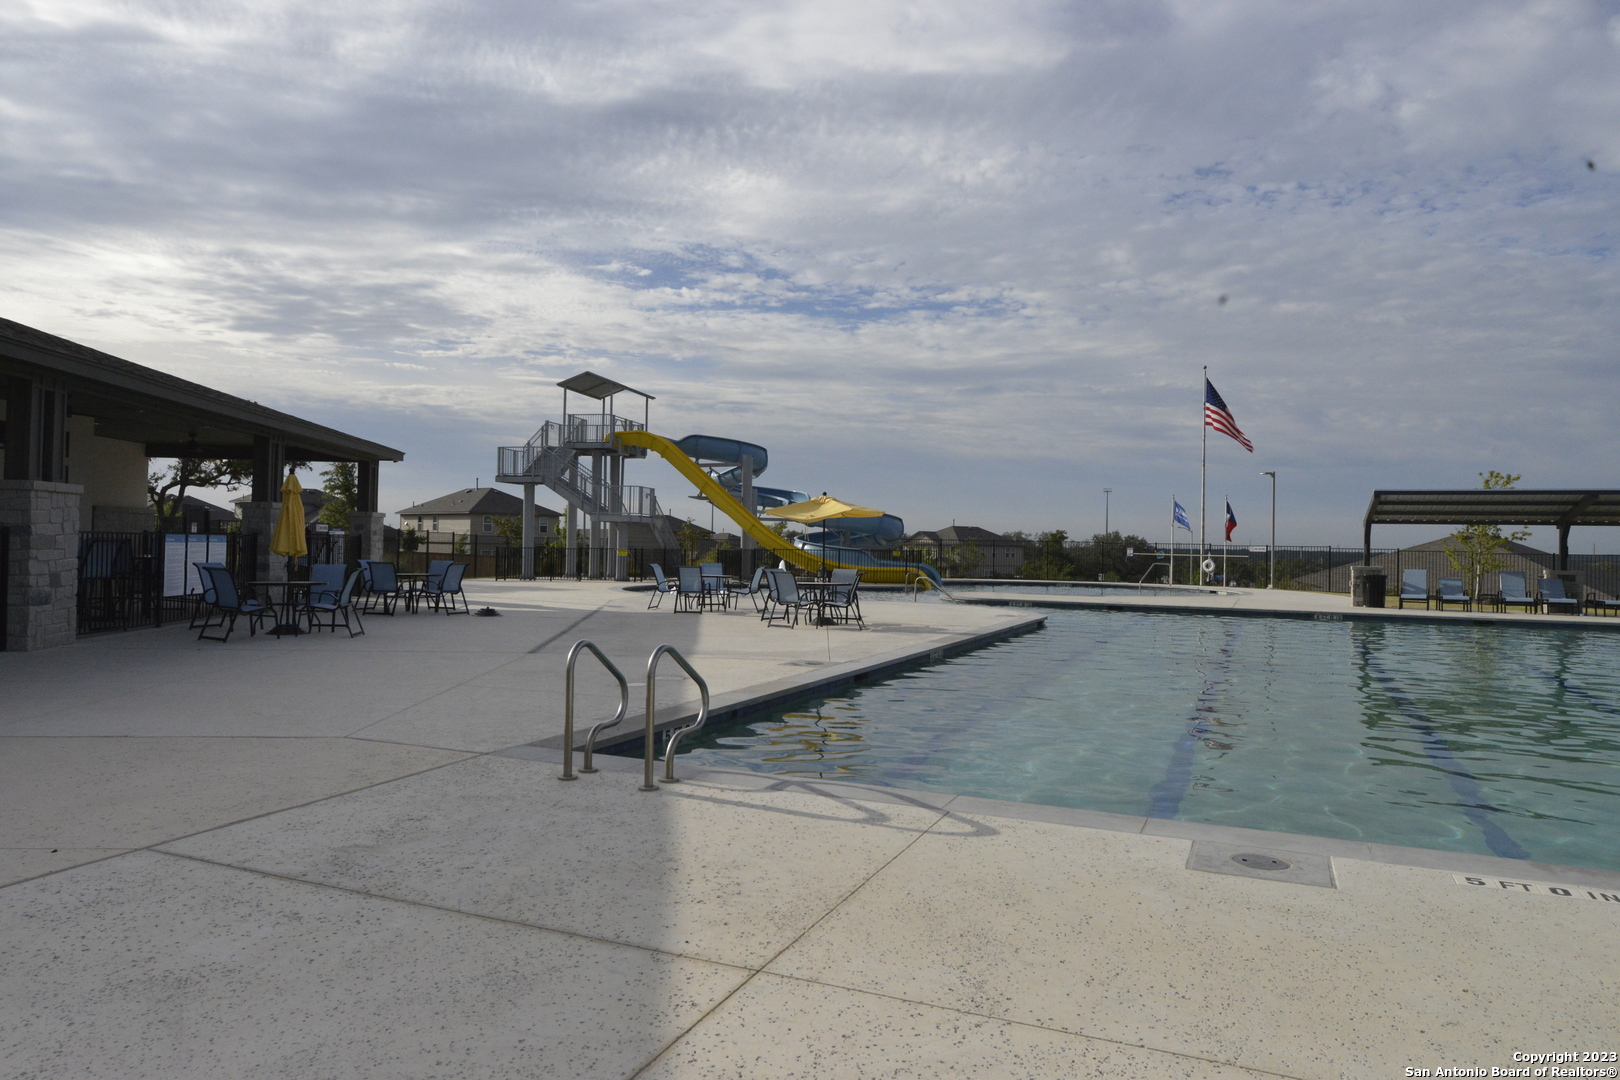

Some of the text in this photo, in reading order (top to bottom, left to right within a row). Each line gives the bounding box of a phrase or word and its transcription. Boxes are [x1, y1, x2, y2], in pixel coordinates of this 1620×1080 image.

[1464, 876, 1487, 886] 5
[1498, 880, 1532, 892] FT
[1586, 891, 1620, 903] IN
